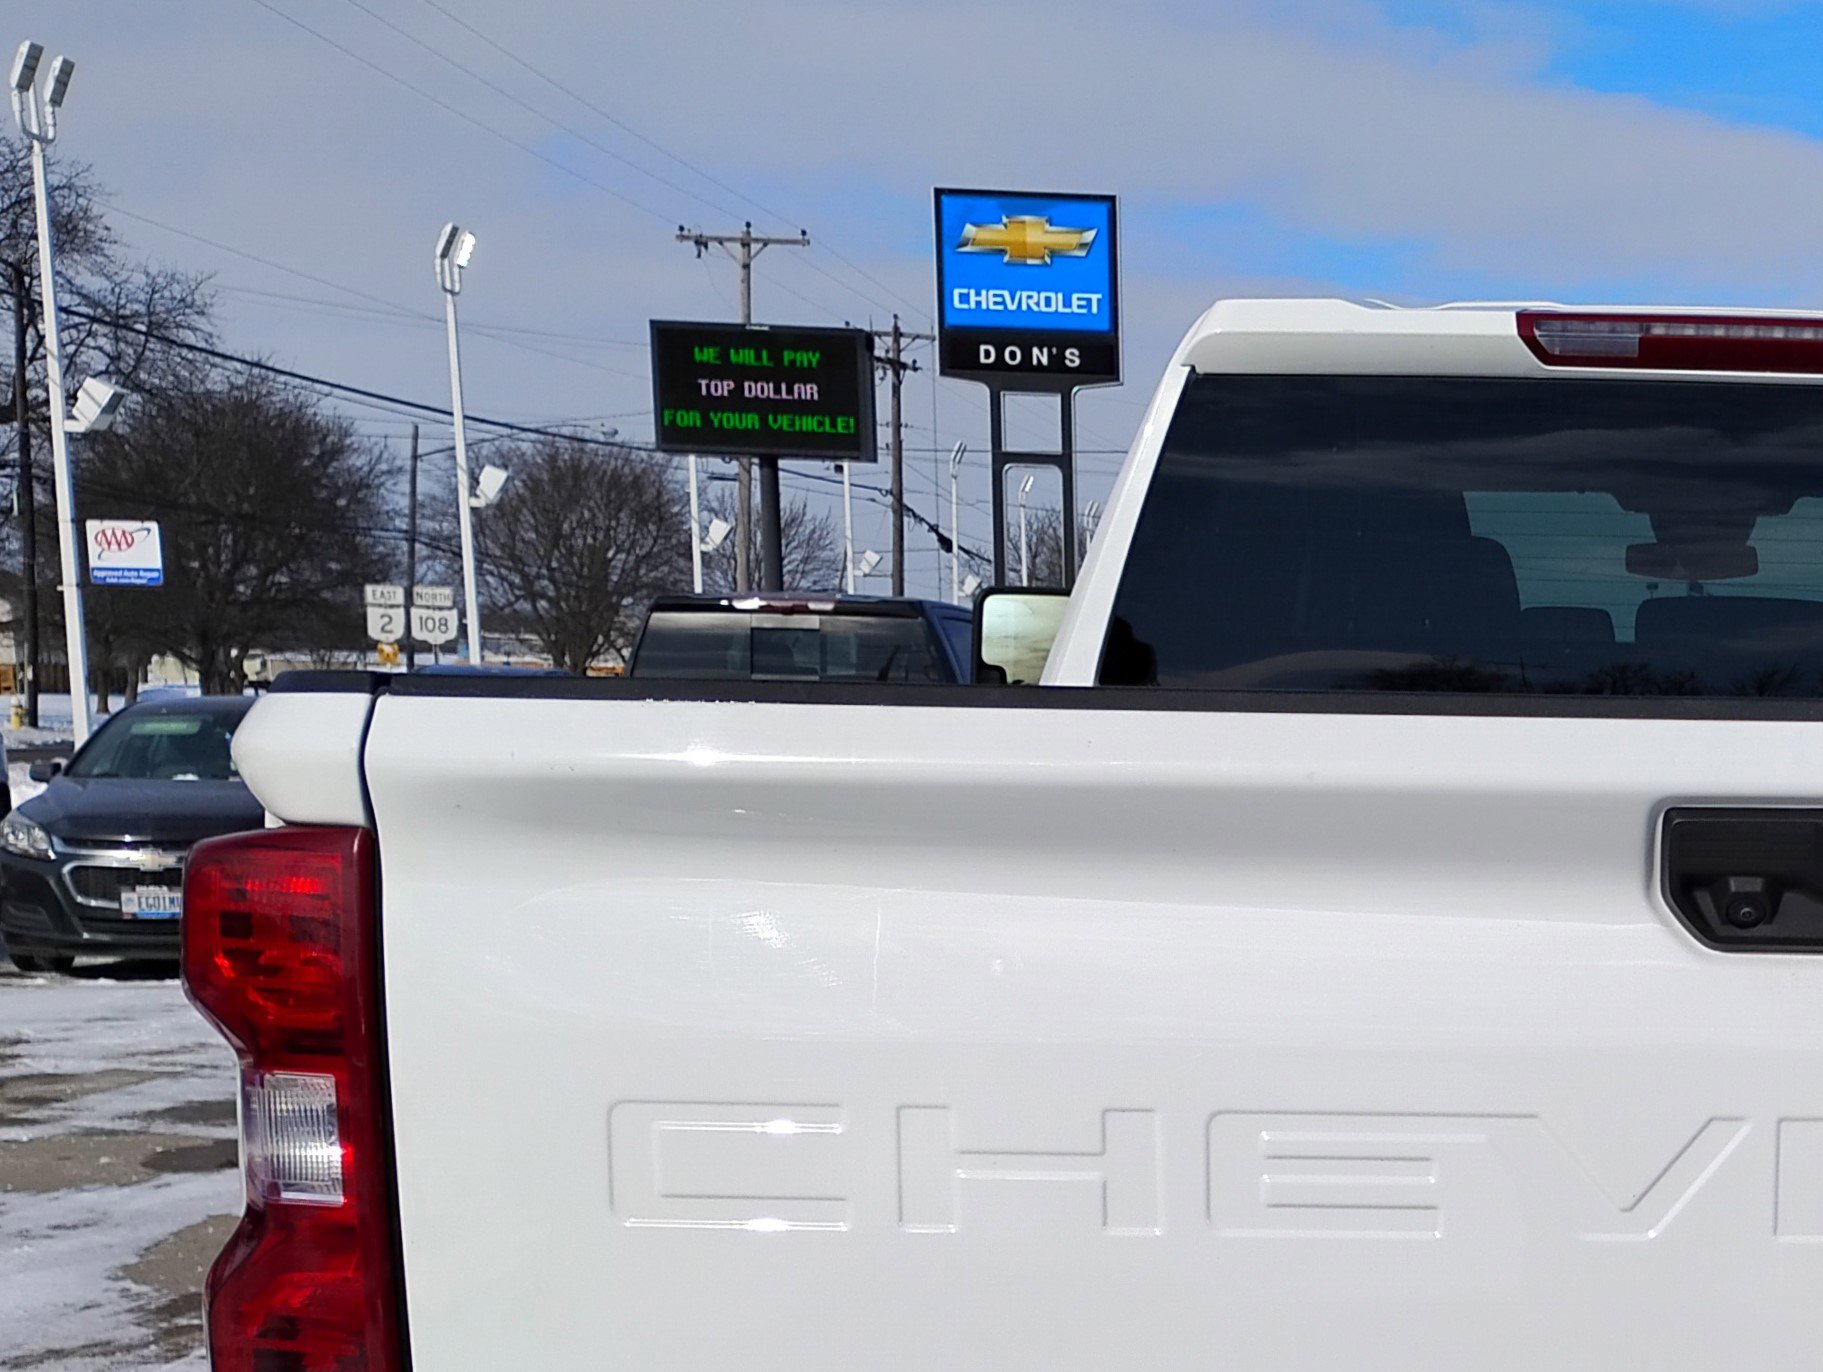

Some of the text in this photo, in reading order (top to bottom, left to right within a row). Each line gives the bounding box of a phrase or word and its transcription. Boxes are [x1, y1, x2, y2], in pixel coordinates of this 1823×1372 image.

[953, 288, 1102, 314] CHEVROLET
[694, 346, 820, 368] WE WILL PAY
[979, 344, 1081, 367] DON'S
[697, 378, 818, 400] TOP DOLLAR
[664, 408, 855, 434] FOR YOUR VEHICLE!
[94, 527, 135, 552] AAA
[372, 589, 397, 601] EAST
[416, 591, 451, 602] NORTH
[380, 613, 394, 634] 2
[419, 615, 449, 634] 108
